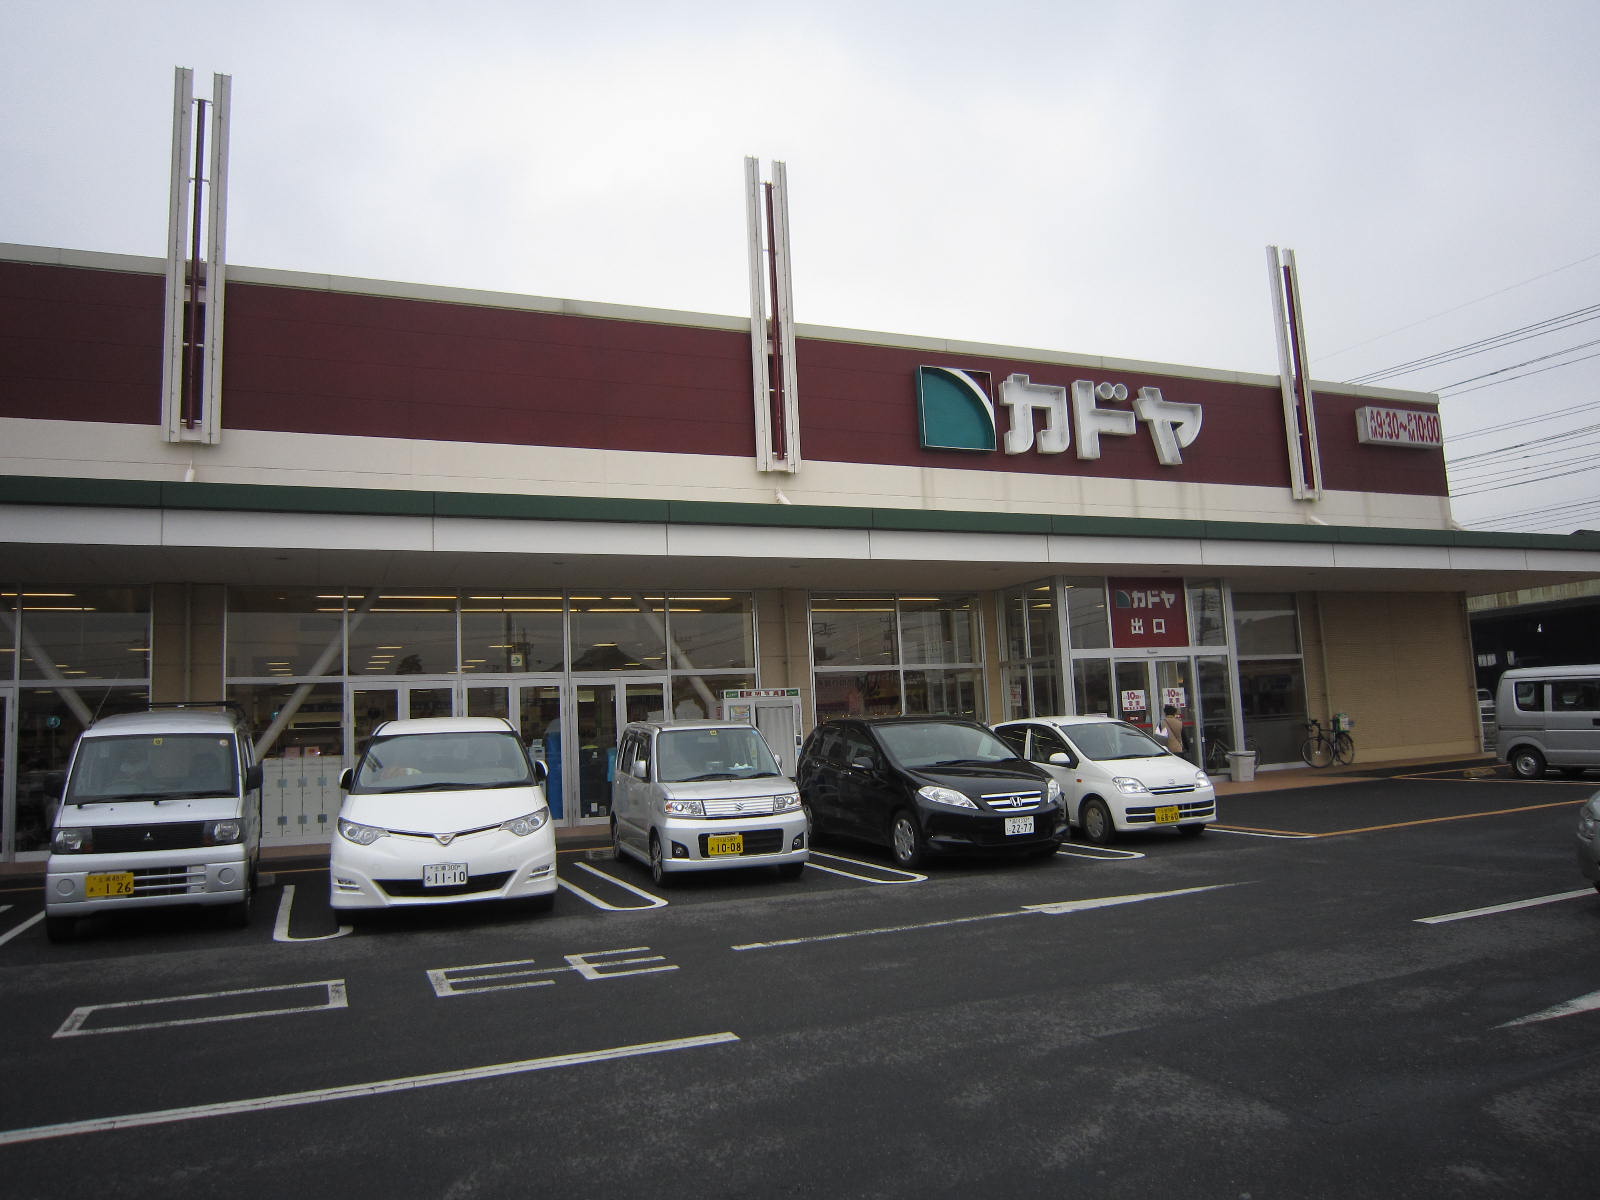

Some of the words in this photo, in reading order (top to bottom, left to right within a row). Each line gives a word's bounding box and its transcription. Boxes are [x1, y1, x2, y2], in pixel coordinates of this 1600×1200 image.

[999, 373, 1203, 465] カドヤ
[1132, 590, 1176, 609] カドヤ
[1131, 617, 1166, 635] 出口
[1012, 823, 1033, 834] 22-77
[717, 843, 741, 853] 10-08
[435, 871, 466, 884] 11-10
